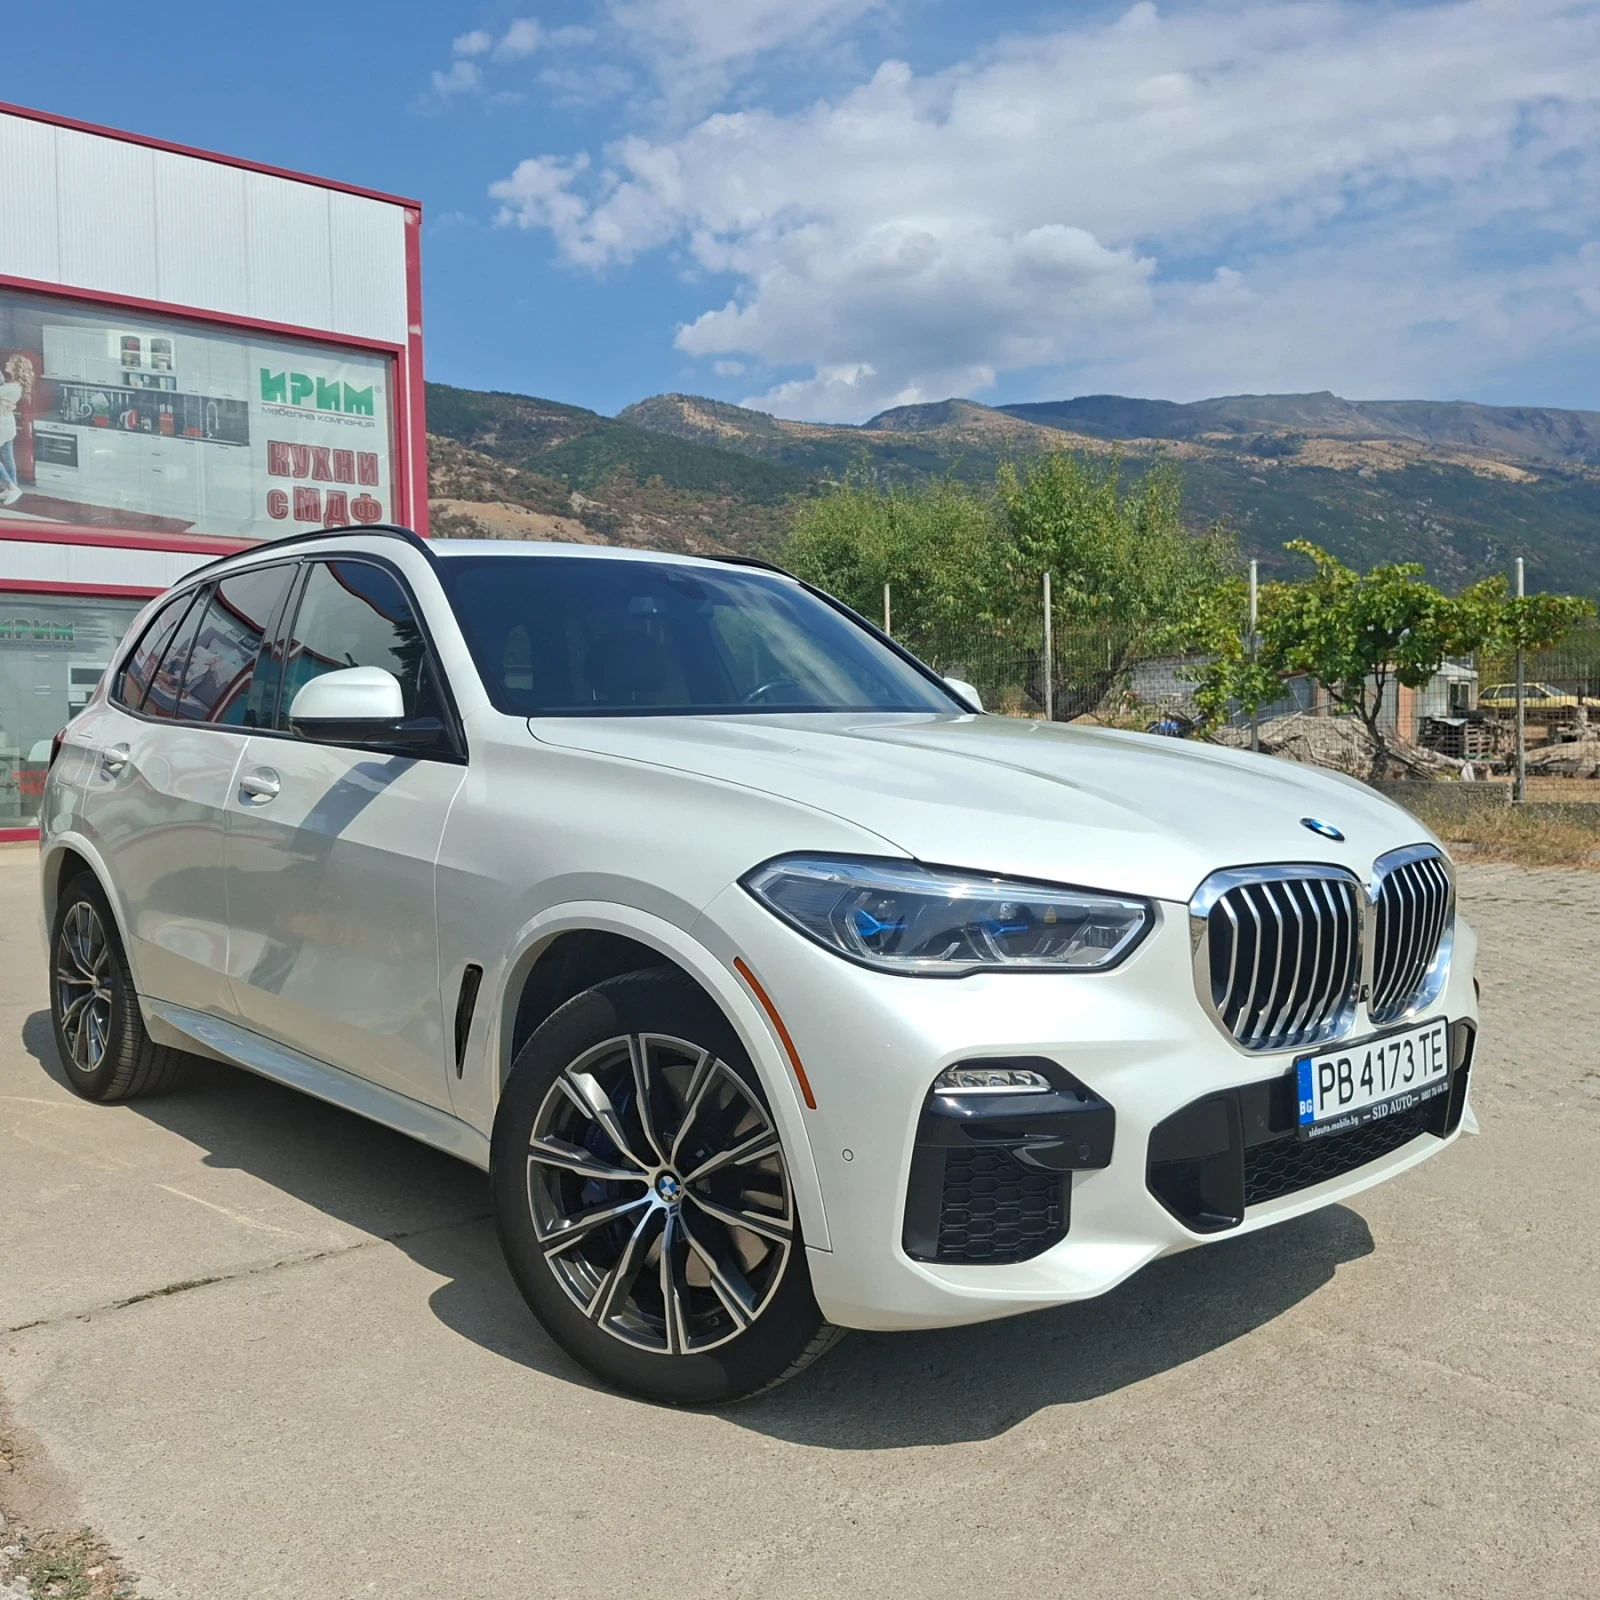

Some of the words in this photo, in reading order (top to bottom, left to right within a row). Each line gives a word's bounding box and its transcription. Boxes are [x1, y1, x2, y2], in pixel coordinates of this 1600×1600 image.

[260, 368, 375, 416] ИРИМ
[317, 415, 375, 428] компания
[267, 440, 379, 487] КУХНИ
[293, 486, 383, 529] МДФ
[1318, 1057, 1354, 1111] PB
[1360, 1039, 1415, 1096] 4173
[1419, 1028, 1443, 1077] TE
[1299, 1100, 1313, 1116] BG
[1372, 1104, 1388, 1120] SID
[1389, 1094, 1413, 1115] AUTO
